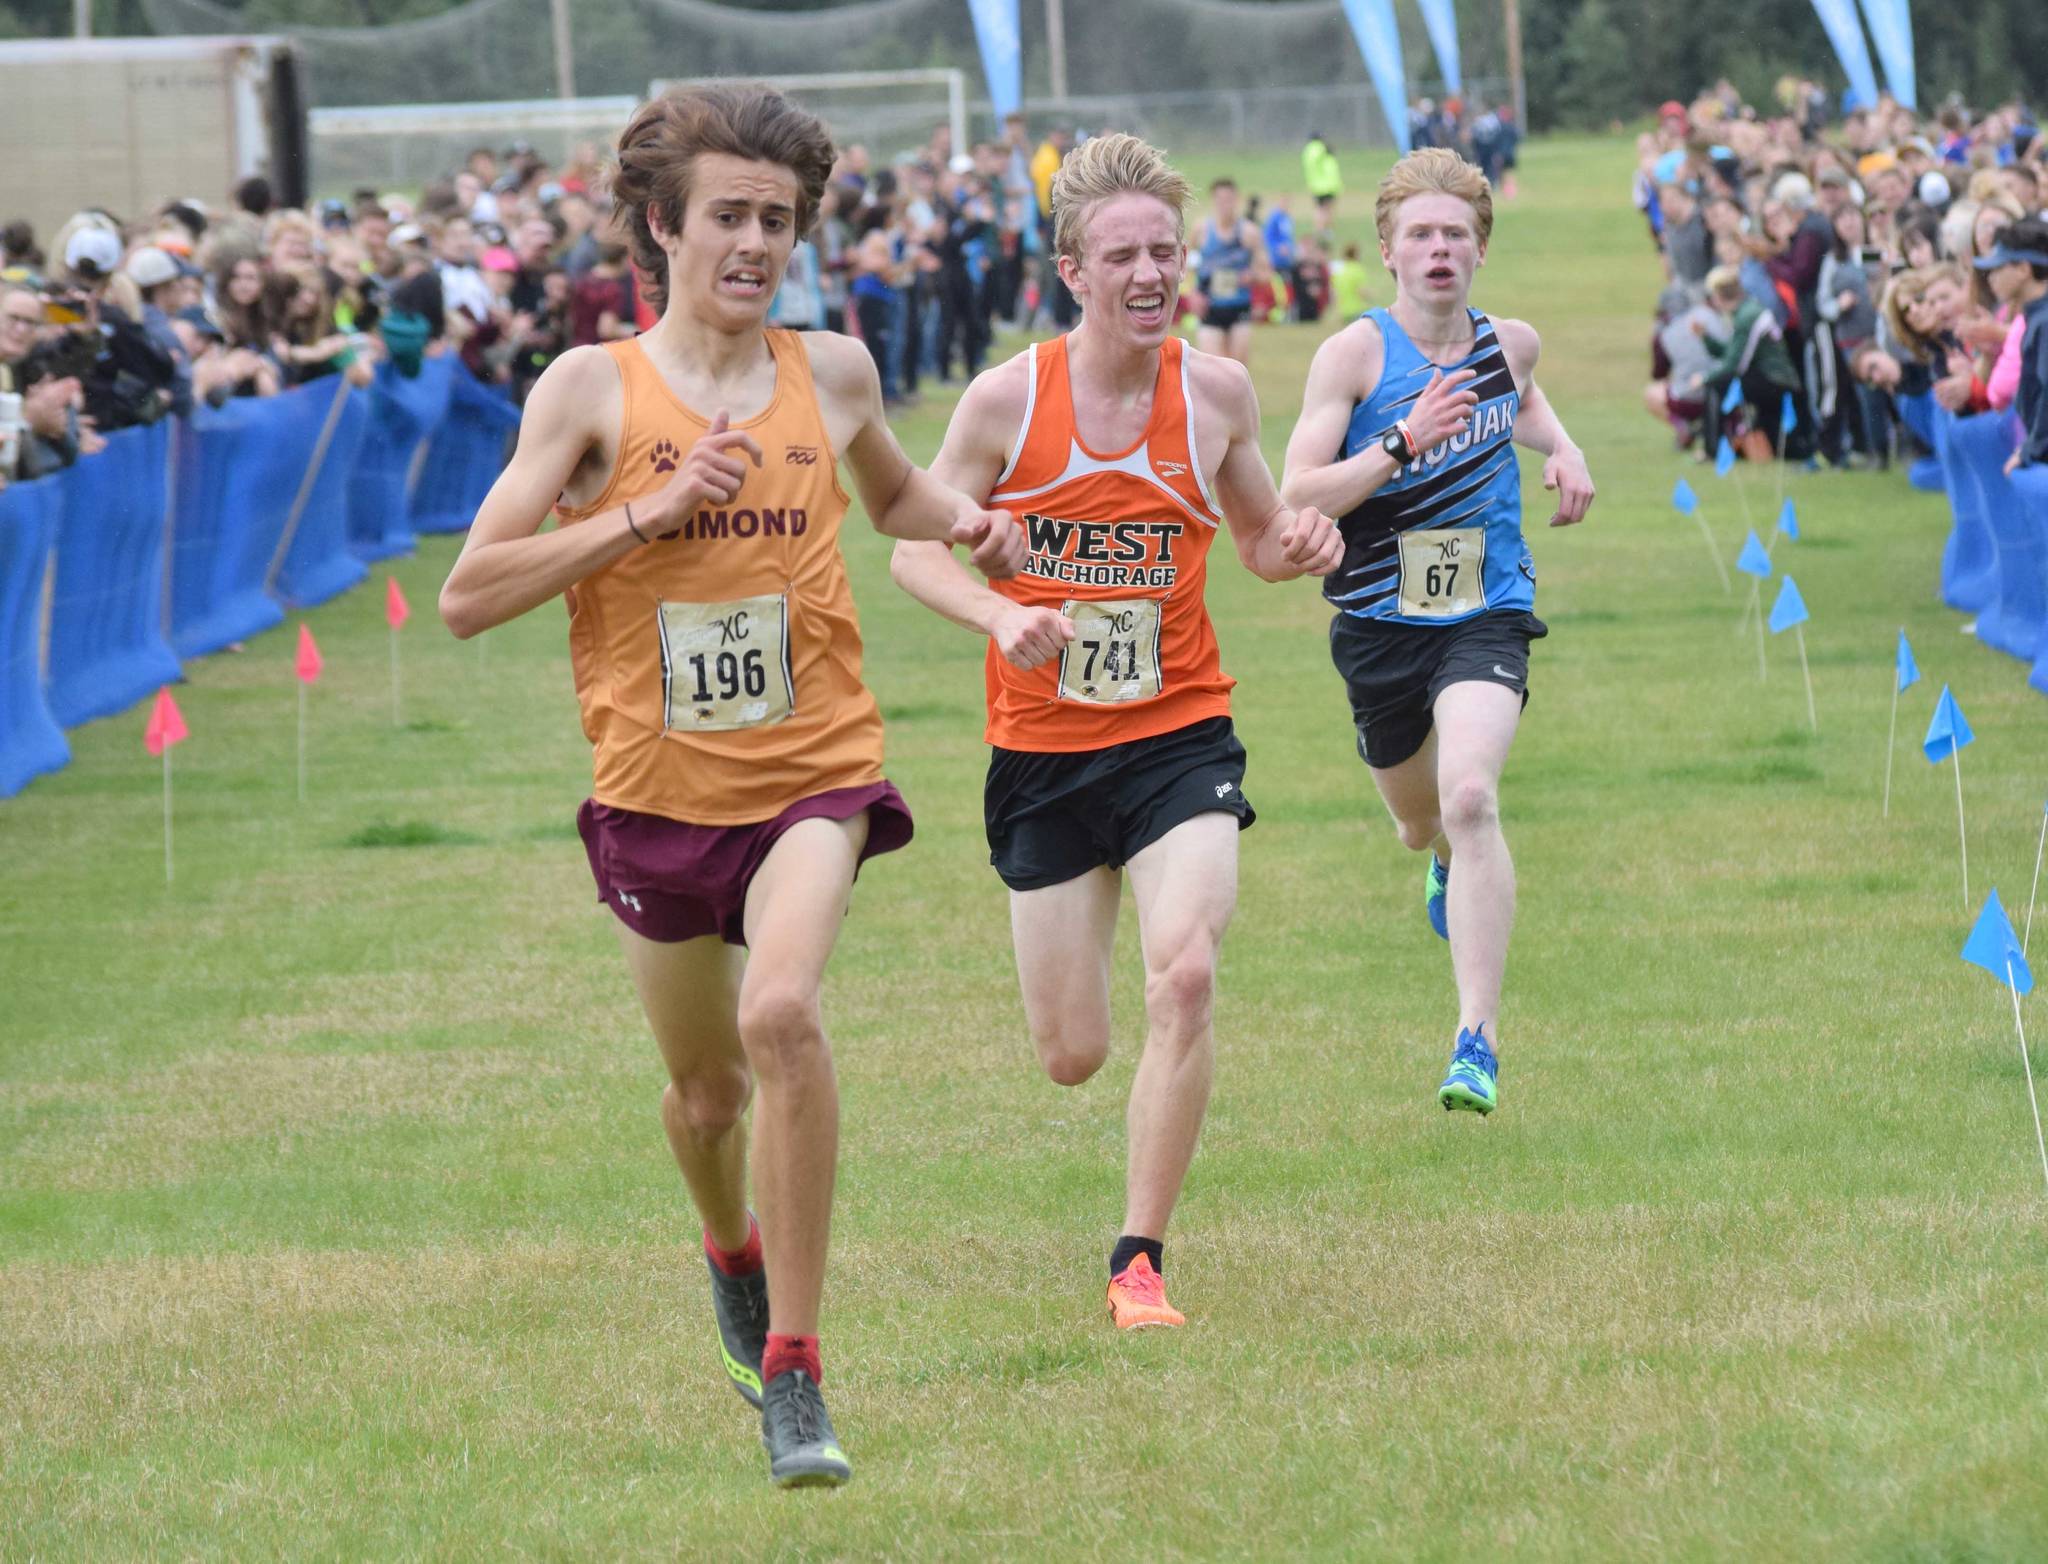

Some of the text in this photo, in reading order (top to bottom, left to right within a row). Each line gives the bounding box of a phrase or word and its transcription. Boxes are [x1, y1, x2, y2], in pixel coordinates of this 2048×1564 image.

[656, 508, 808, 540] IMOND
[1023, 514, 1184, 564] WEST
[1440, 537, 1460, 561] XC
[1020, 554, 1177, 588] ANCHORAGE
[1426, 564, 1459, 597] 67
[719, 611, 749, 647] XC
[1107, 610, 1133, 637] XC
[689, 649, 765, 702] 196
[1082, 640, 1140, 682] 741
